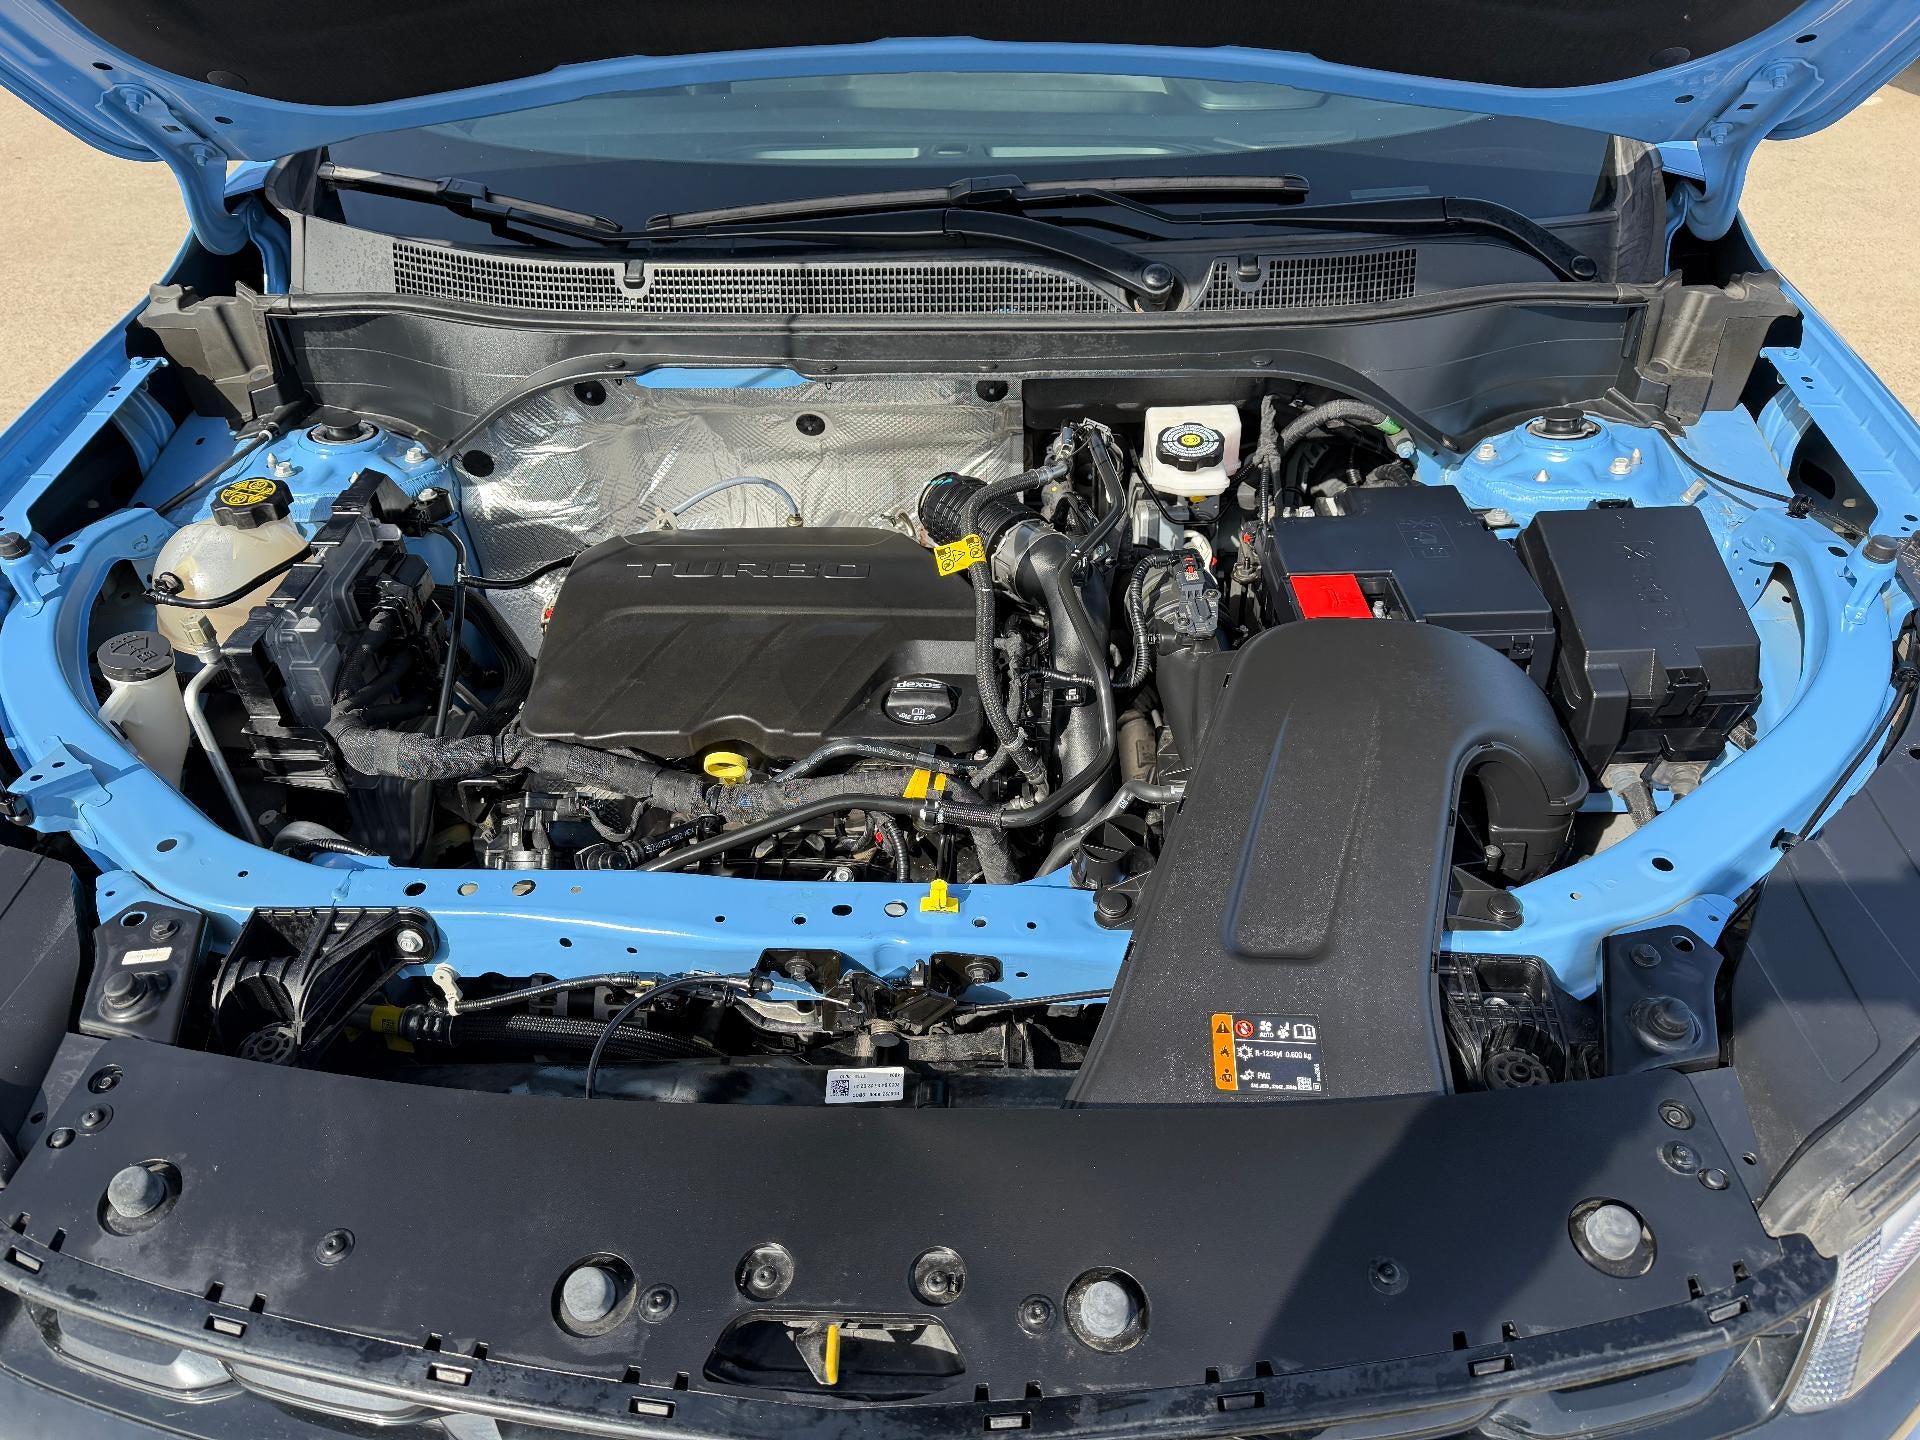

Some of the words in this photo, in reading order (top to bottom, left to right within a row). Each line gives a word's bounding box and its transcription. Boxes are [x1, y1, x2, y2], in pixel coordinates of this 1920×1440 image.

[625, 561, 871, 580] TURBO
[896, 680, 943, 689] dexos
[1303, 1052, 1312, 1060] kg
[1257, 1072, 1271, 1080] PAG
